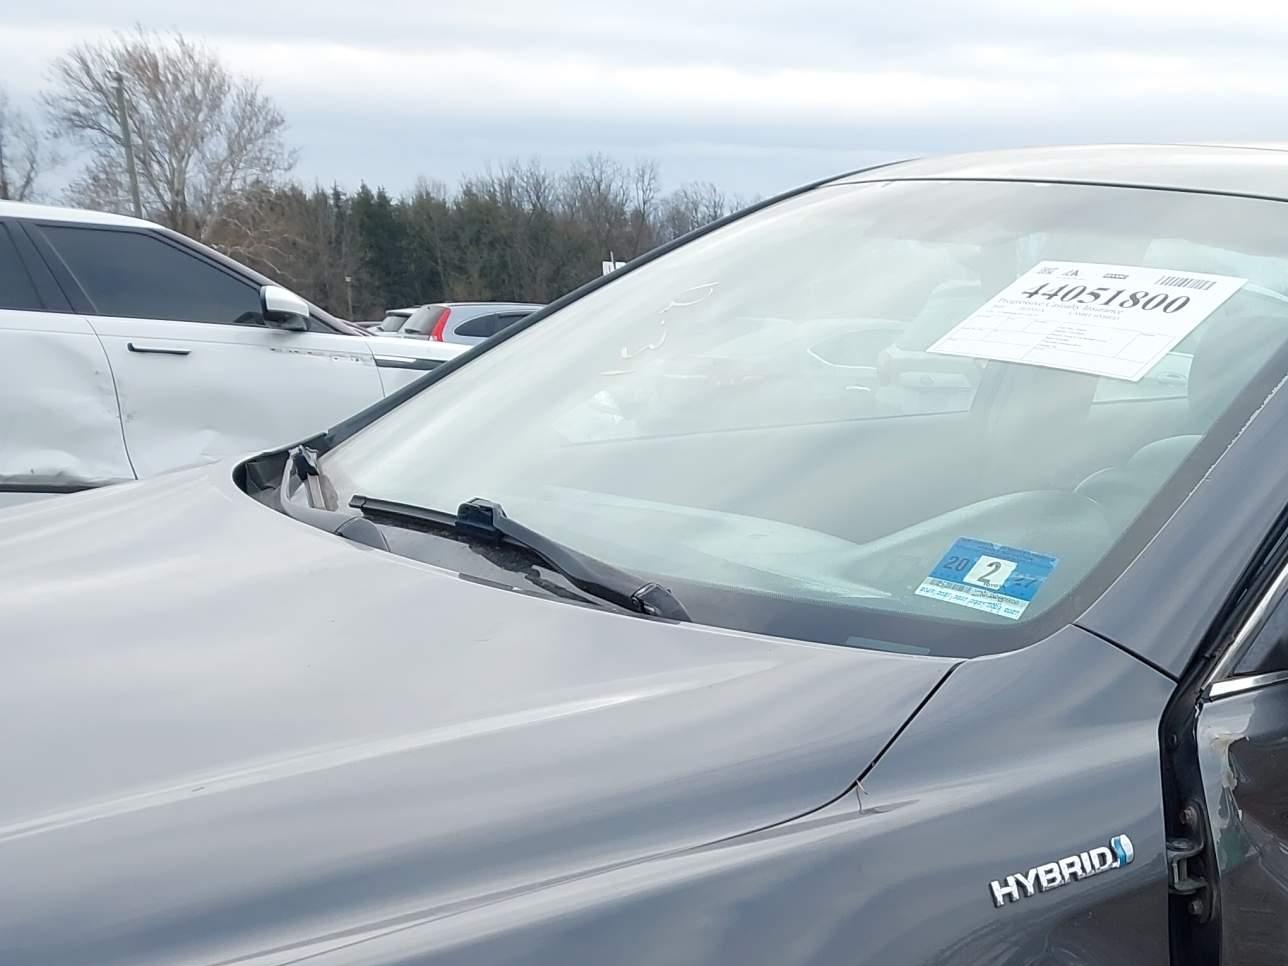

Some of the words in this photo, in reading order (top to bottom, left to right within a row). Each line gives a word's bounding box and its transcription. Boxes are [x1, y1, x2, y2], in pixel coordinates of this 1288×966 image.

[1022, 281, 1191, 314] 44051800
[944, 556, 970, 572] 20
[977, 561, 1002, 584] 2
[989, 846, 1114, 908] HYBRID
